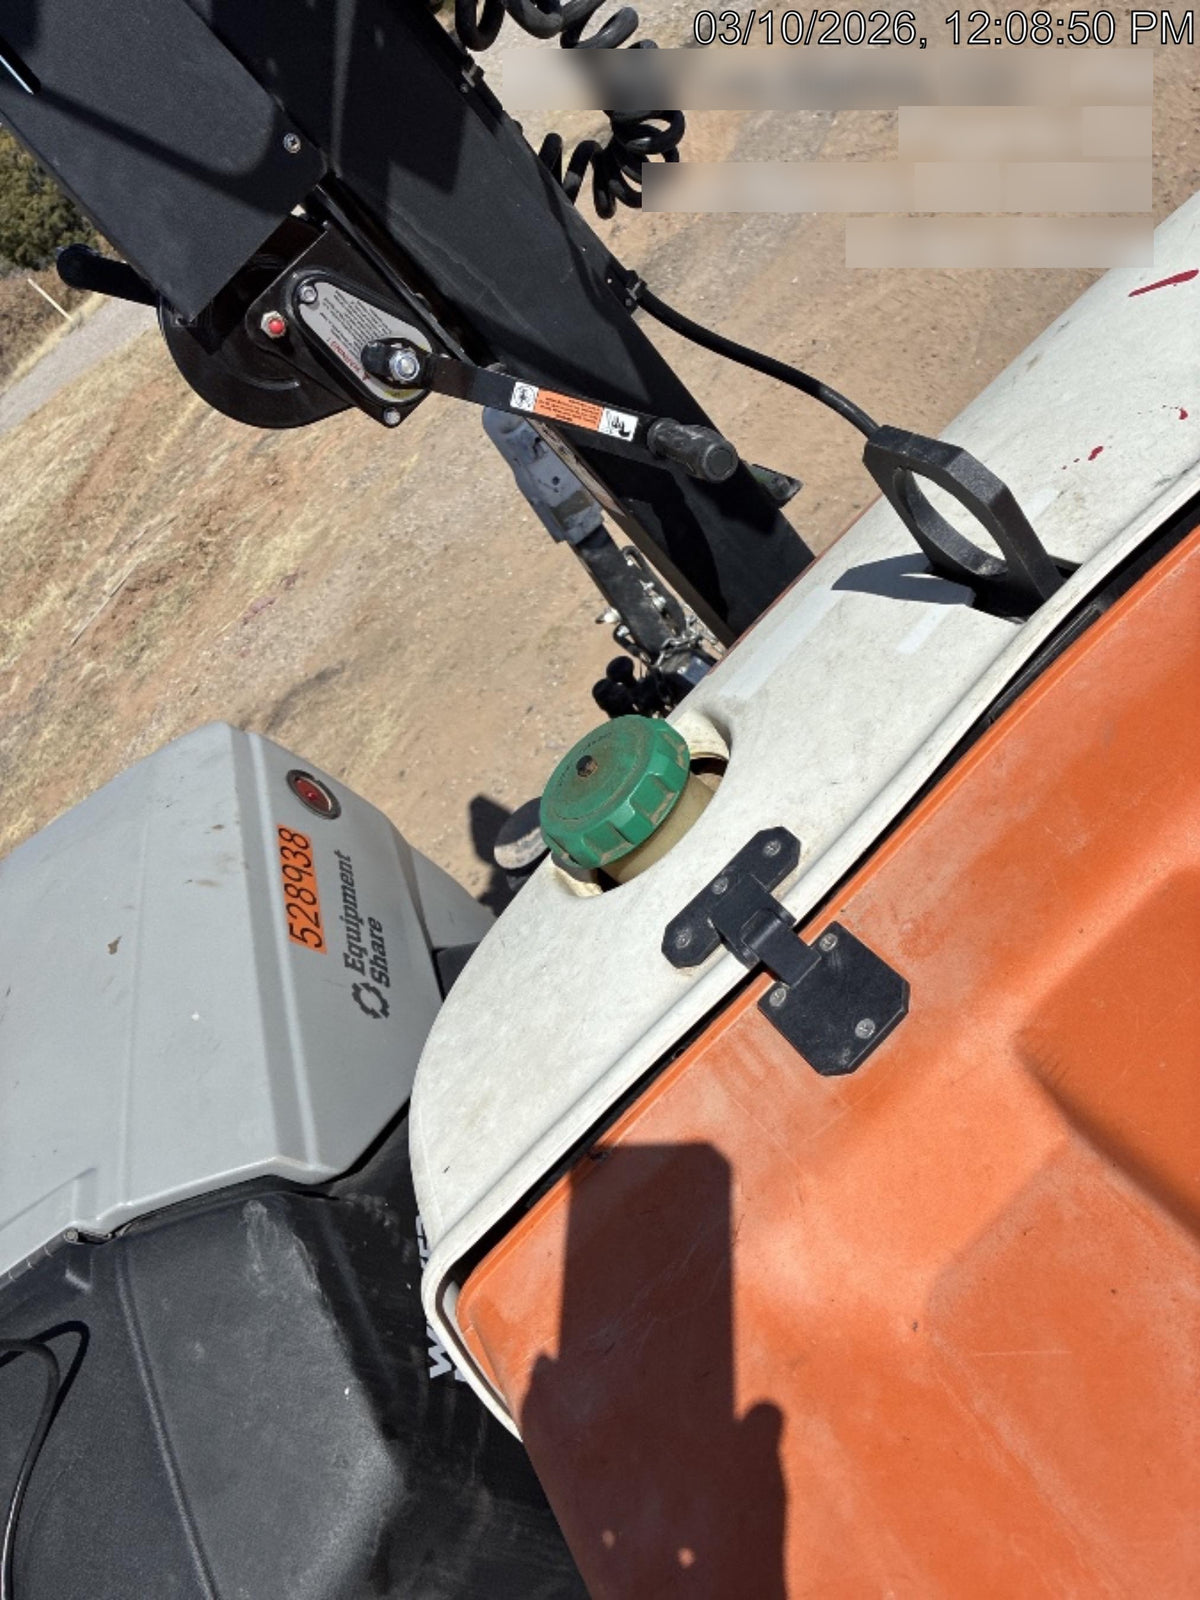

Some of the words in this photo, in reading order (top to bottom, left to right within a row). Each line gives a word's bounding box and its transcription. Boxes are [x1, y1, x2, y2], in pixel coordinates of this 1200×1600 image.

[278, 827, 323, 949] 528938
[334, 849, 368, 977] Equipment
[367, 916, 391, 989] Share
